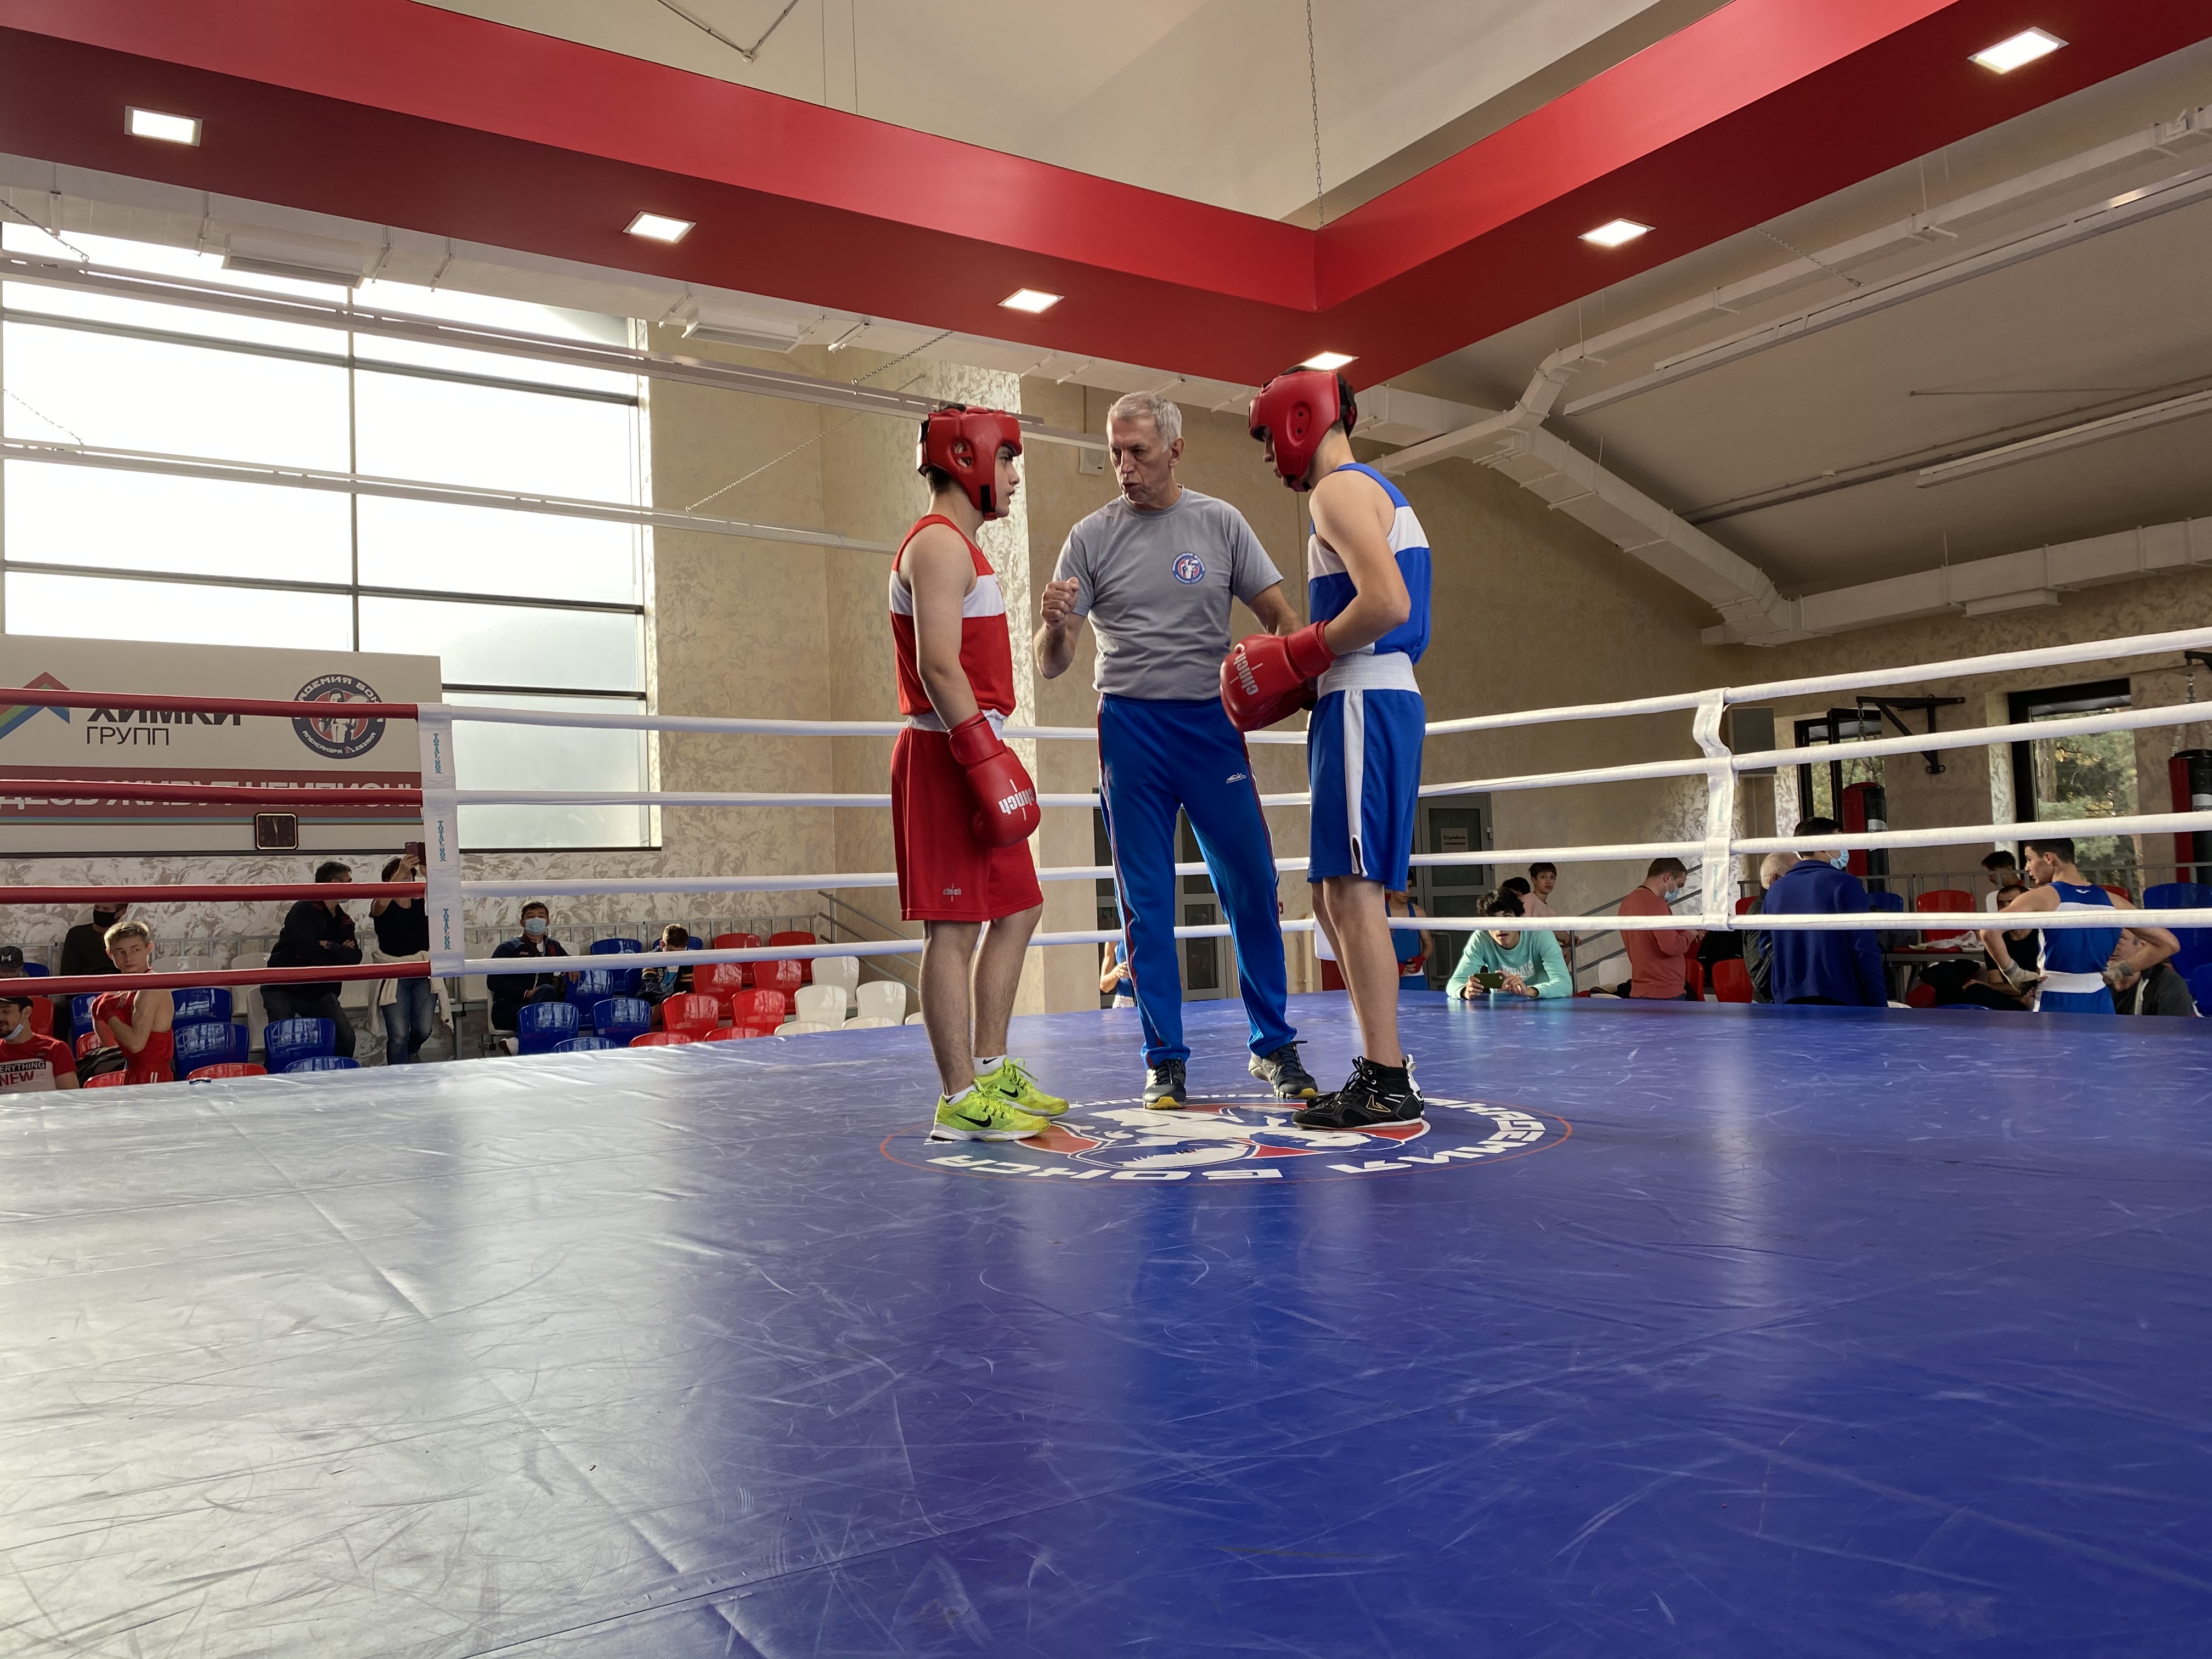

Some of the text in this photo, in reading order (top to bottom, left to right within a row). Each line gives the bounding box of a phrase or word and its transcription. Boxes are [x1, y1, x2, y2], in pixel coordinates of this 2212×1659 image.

[1233, 652, 1259, 696] clinch
[87, 726, 169, 746] ГРУПП
[998, 788, 1035, 815] clinch
[0, 1070, 34, 1086] NEW
[925, 1155, 1283, 1180] БОКСА
